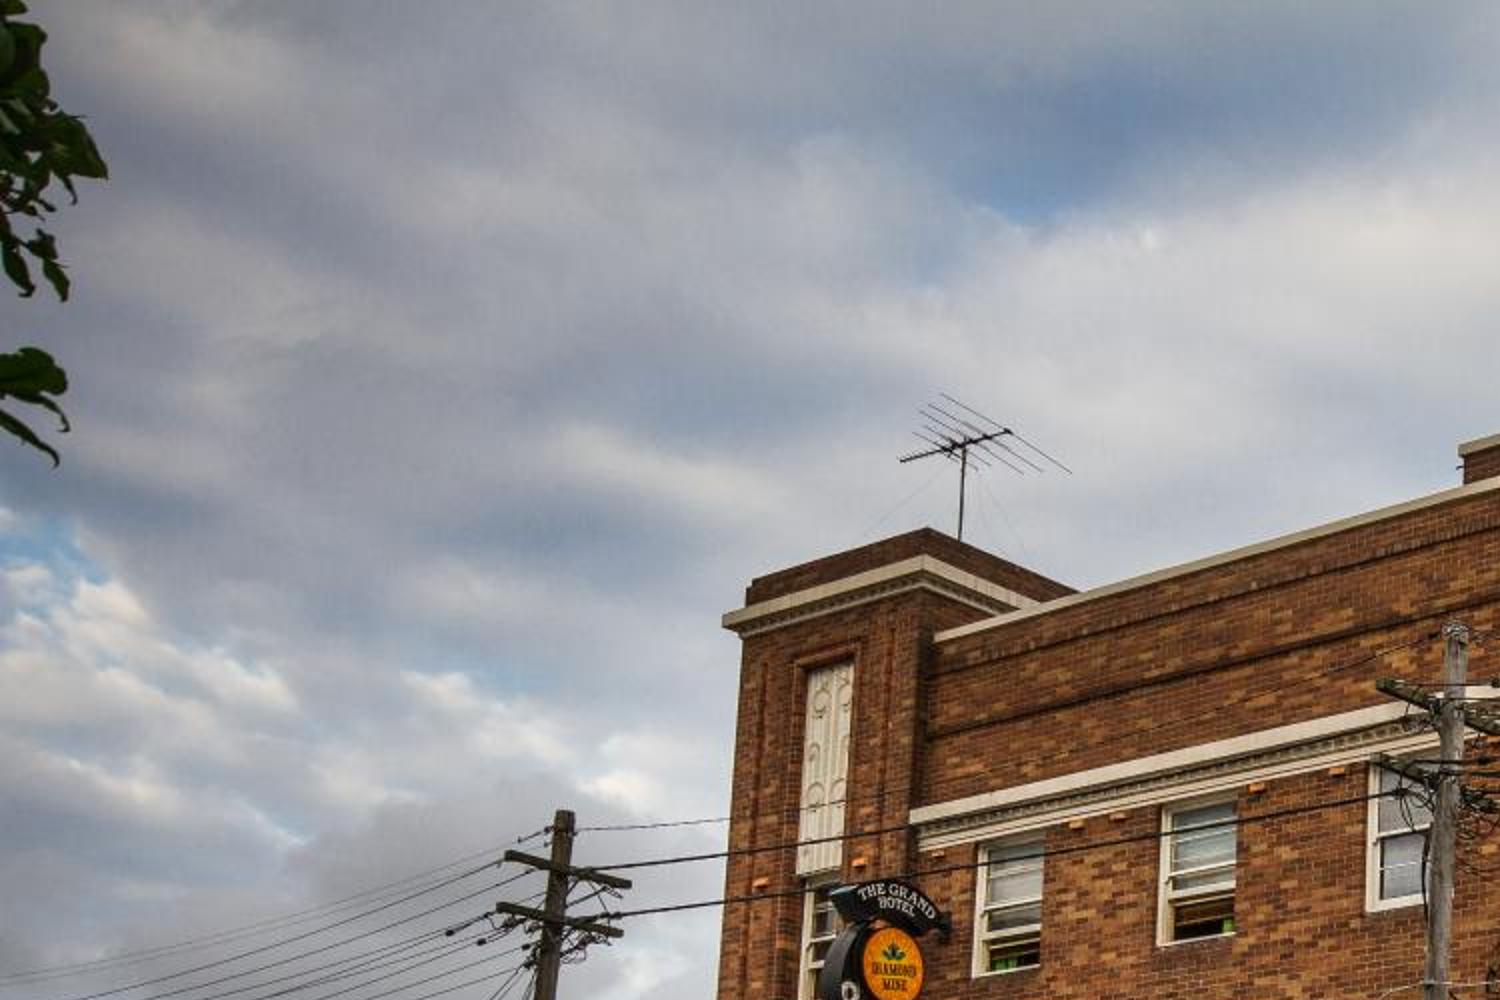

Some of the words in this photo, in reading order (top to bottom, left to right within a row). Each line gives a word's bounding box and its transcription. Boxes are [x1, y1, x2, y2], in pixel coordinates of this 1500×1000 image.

[857, 883, 885, 901] THE
[887, 882, 936, 919] GRAND
[878, 896, 915, 917] HOTEL
